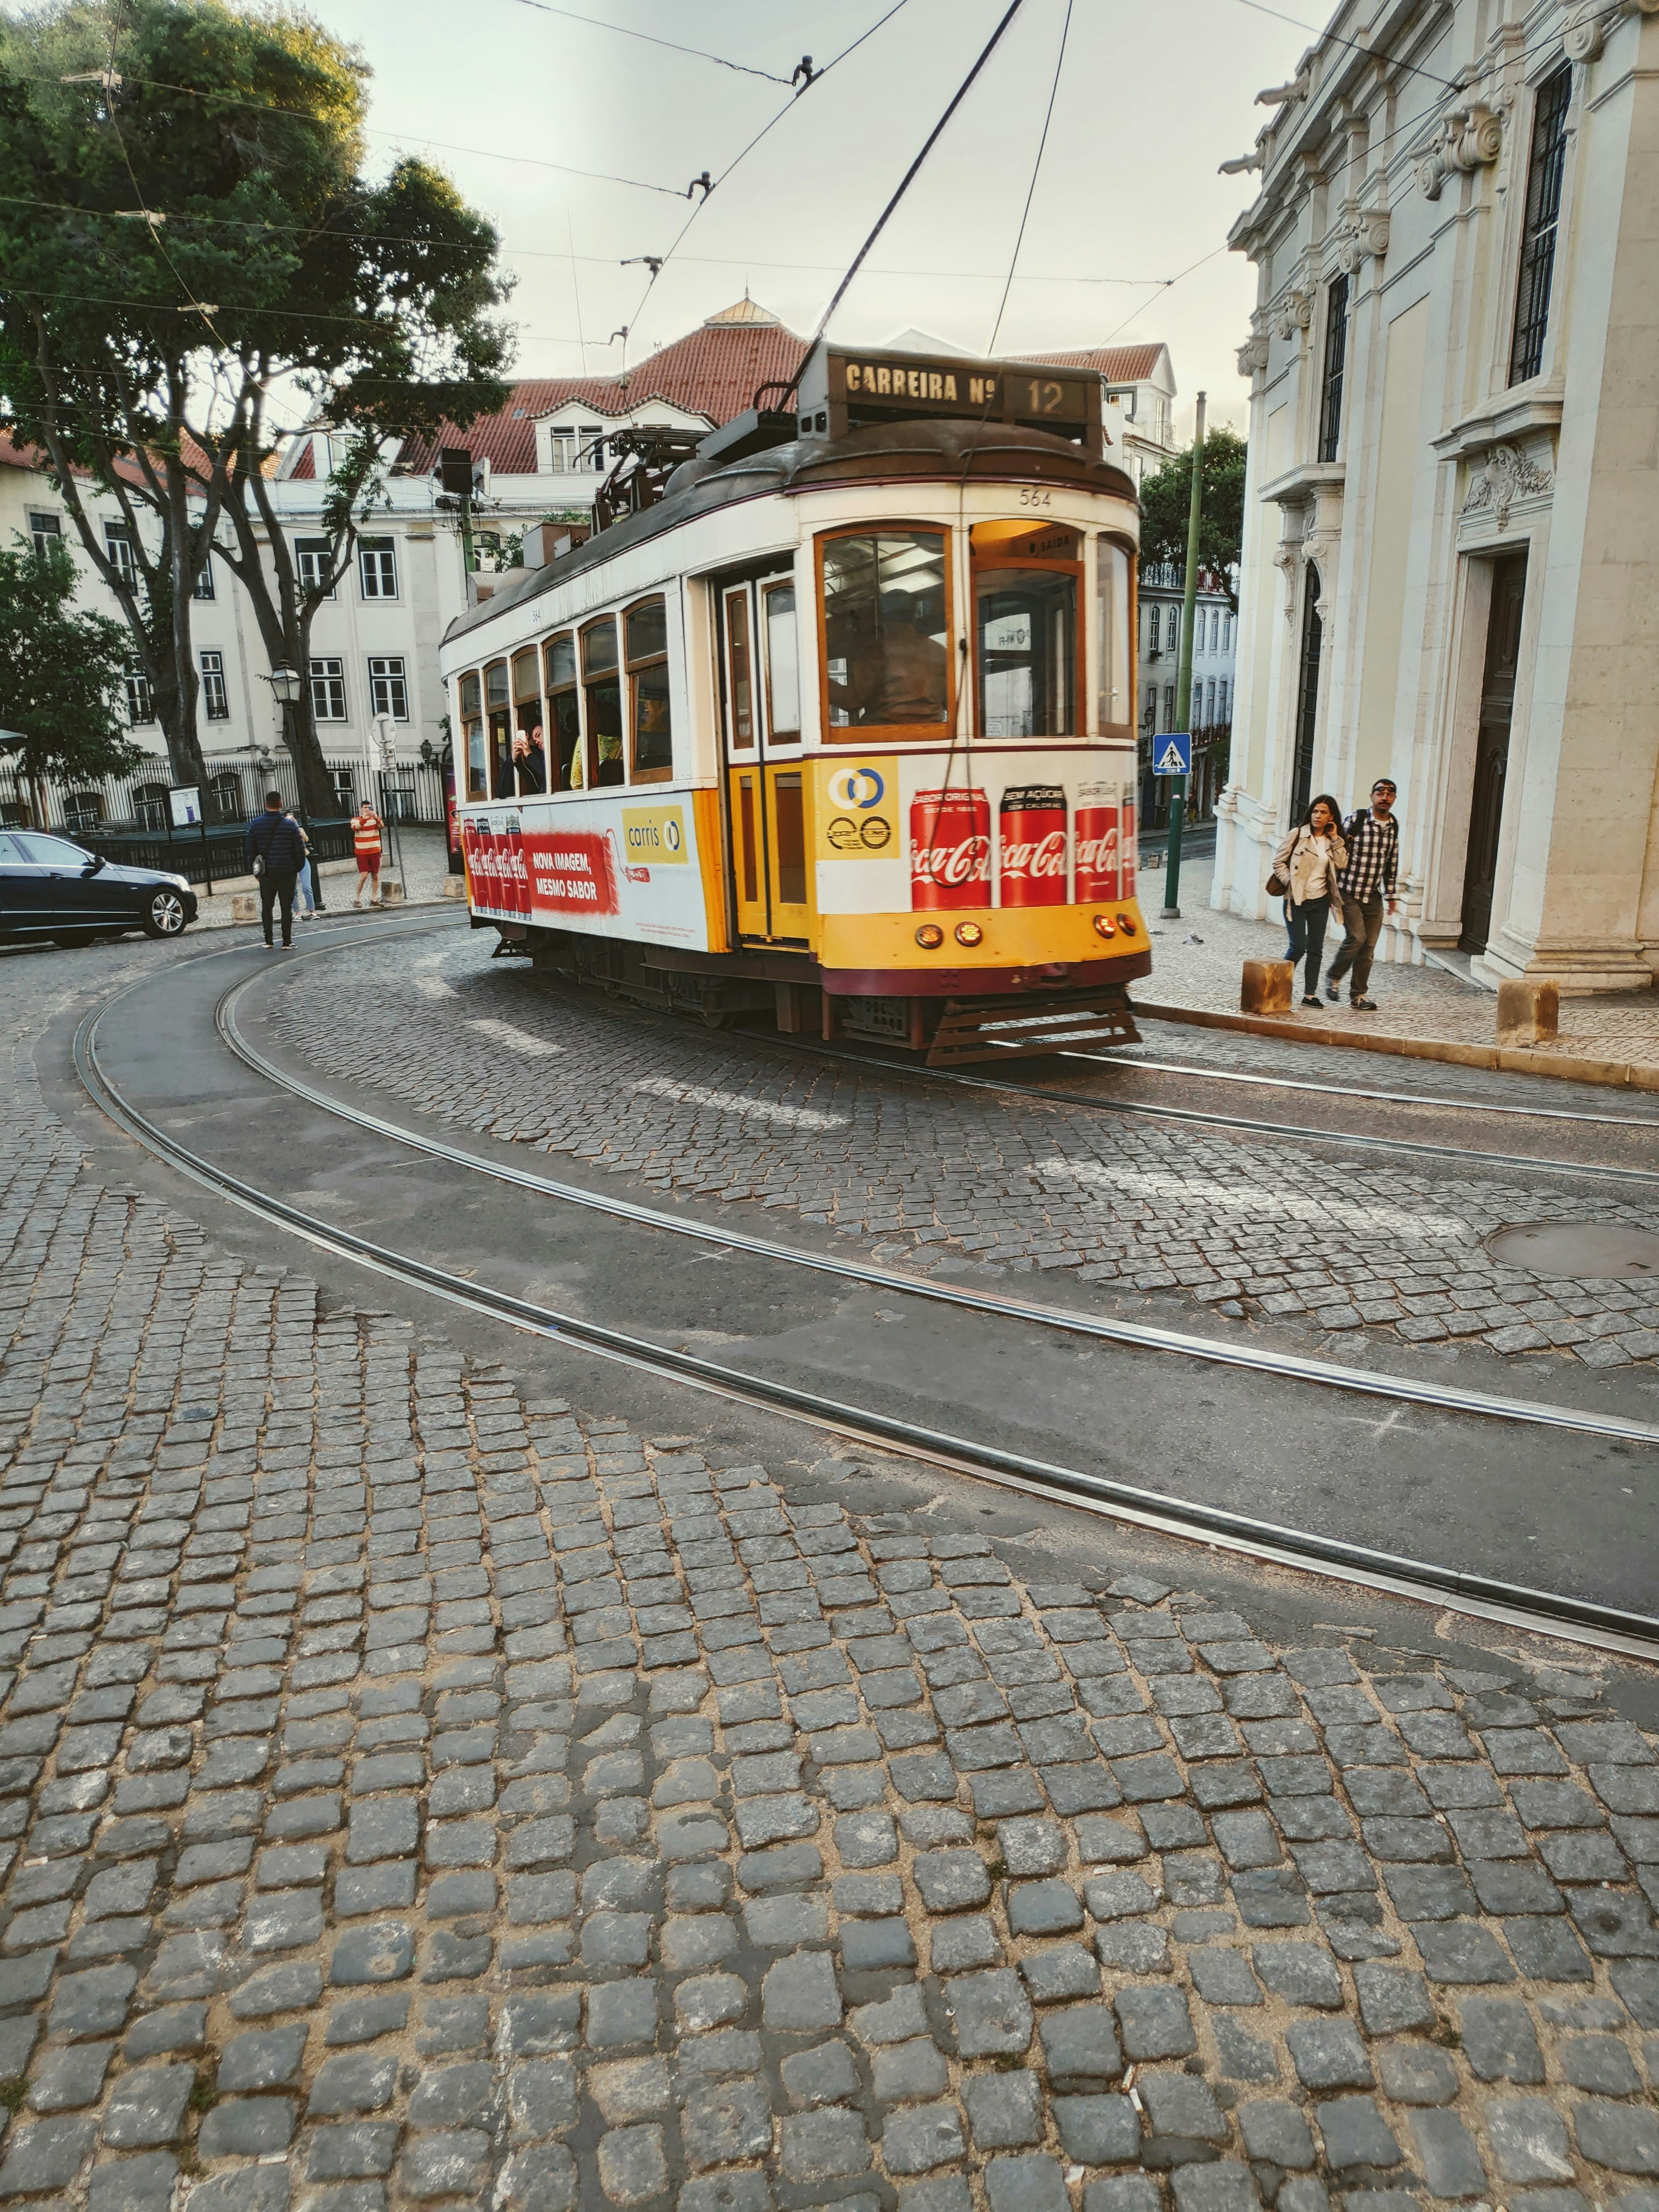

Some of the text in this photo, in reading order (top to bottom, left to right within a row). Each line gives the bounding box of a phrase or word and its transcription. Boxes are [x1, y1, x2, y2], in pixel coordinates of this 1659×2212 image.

[846, 364, 958, 402] CARREIRA
[1028, 379, 1064, 414] 12
[1019, 489, 1051, 507] 564
[533, 608, 541, 623] 564
[912, 792, 988, 805] SABOR ORIGNAL
[1003, 791, 1025, 801] SEM
[629, 819, 659, 847] carris
[533, 852, 592, 876] NOVA IMAGEM,
[535, 878, 597, 900] MESMO SABOR
